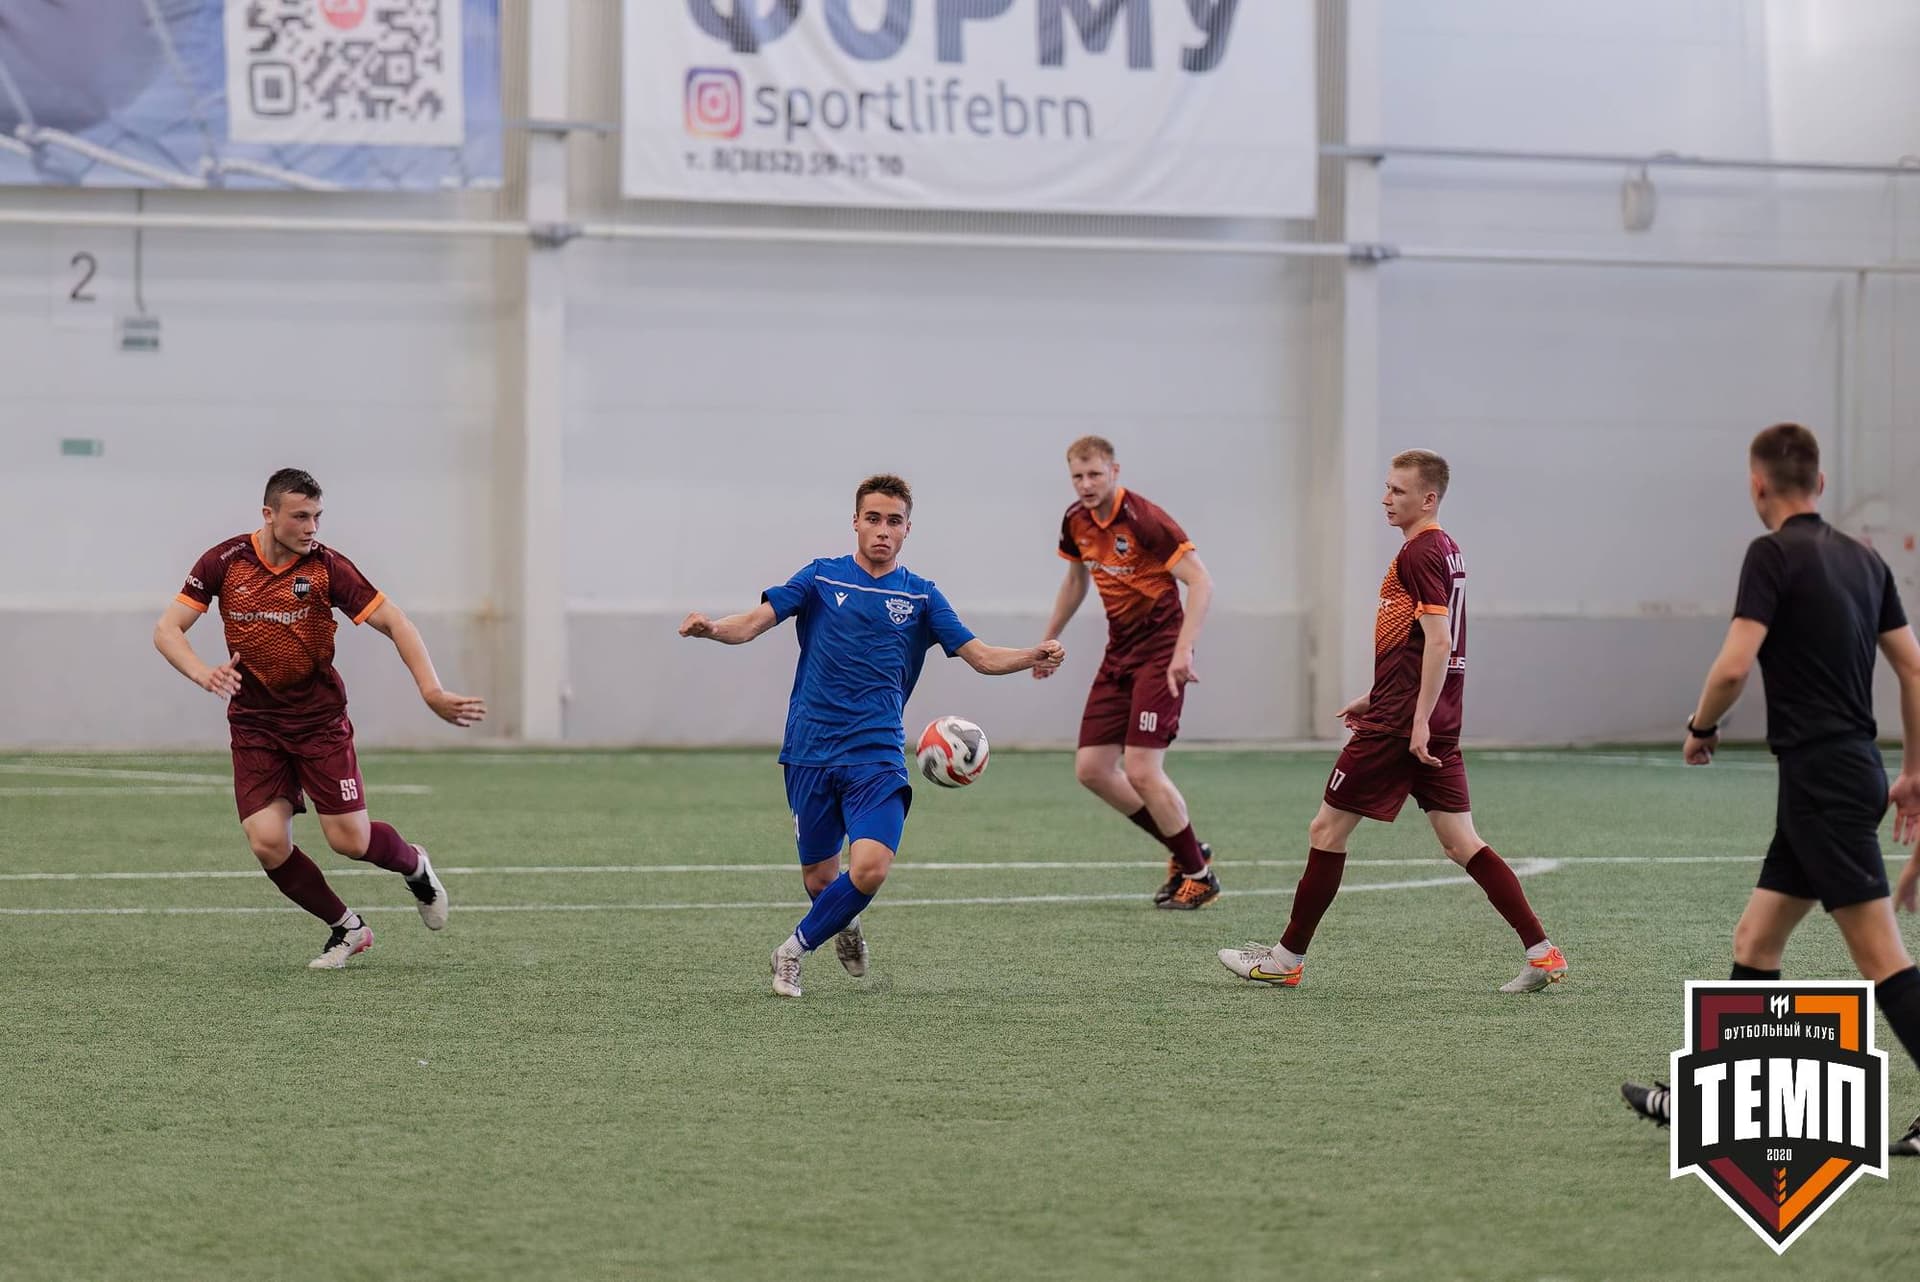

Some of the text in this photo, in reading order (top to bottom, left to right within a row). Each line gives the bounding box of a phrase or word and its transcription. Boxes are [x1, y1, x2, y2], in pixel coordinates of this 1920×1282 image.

[754, 78, 1092, 143] sportlifebrn
[71, 250, 97, 303] 2
[1139, 711, 1158, 733] 90
[340, 778, 359, 802] 55
[1329, 767, 1347, 792] 17
